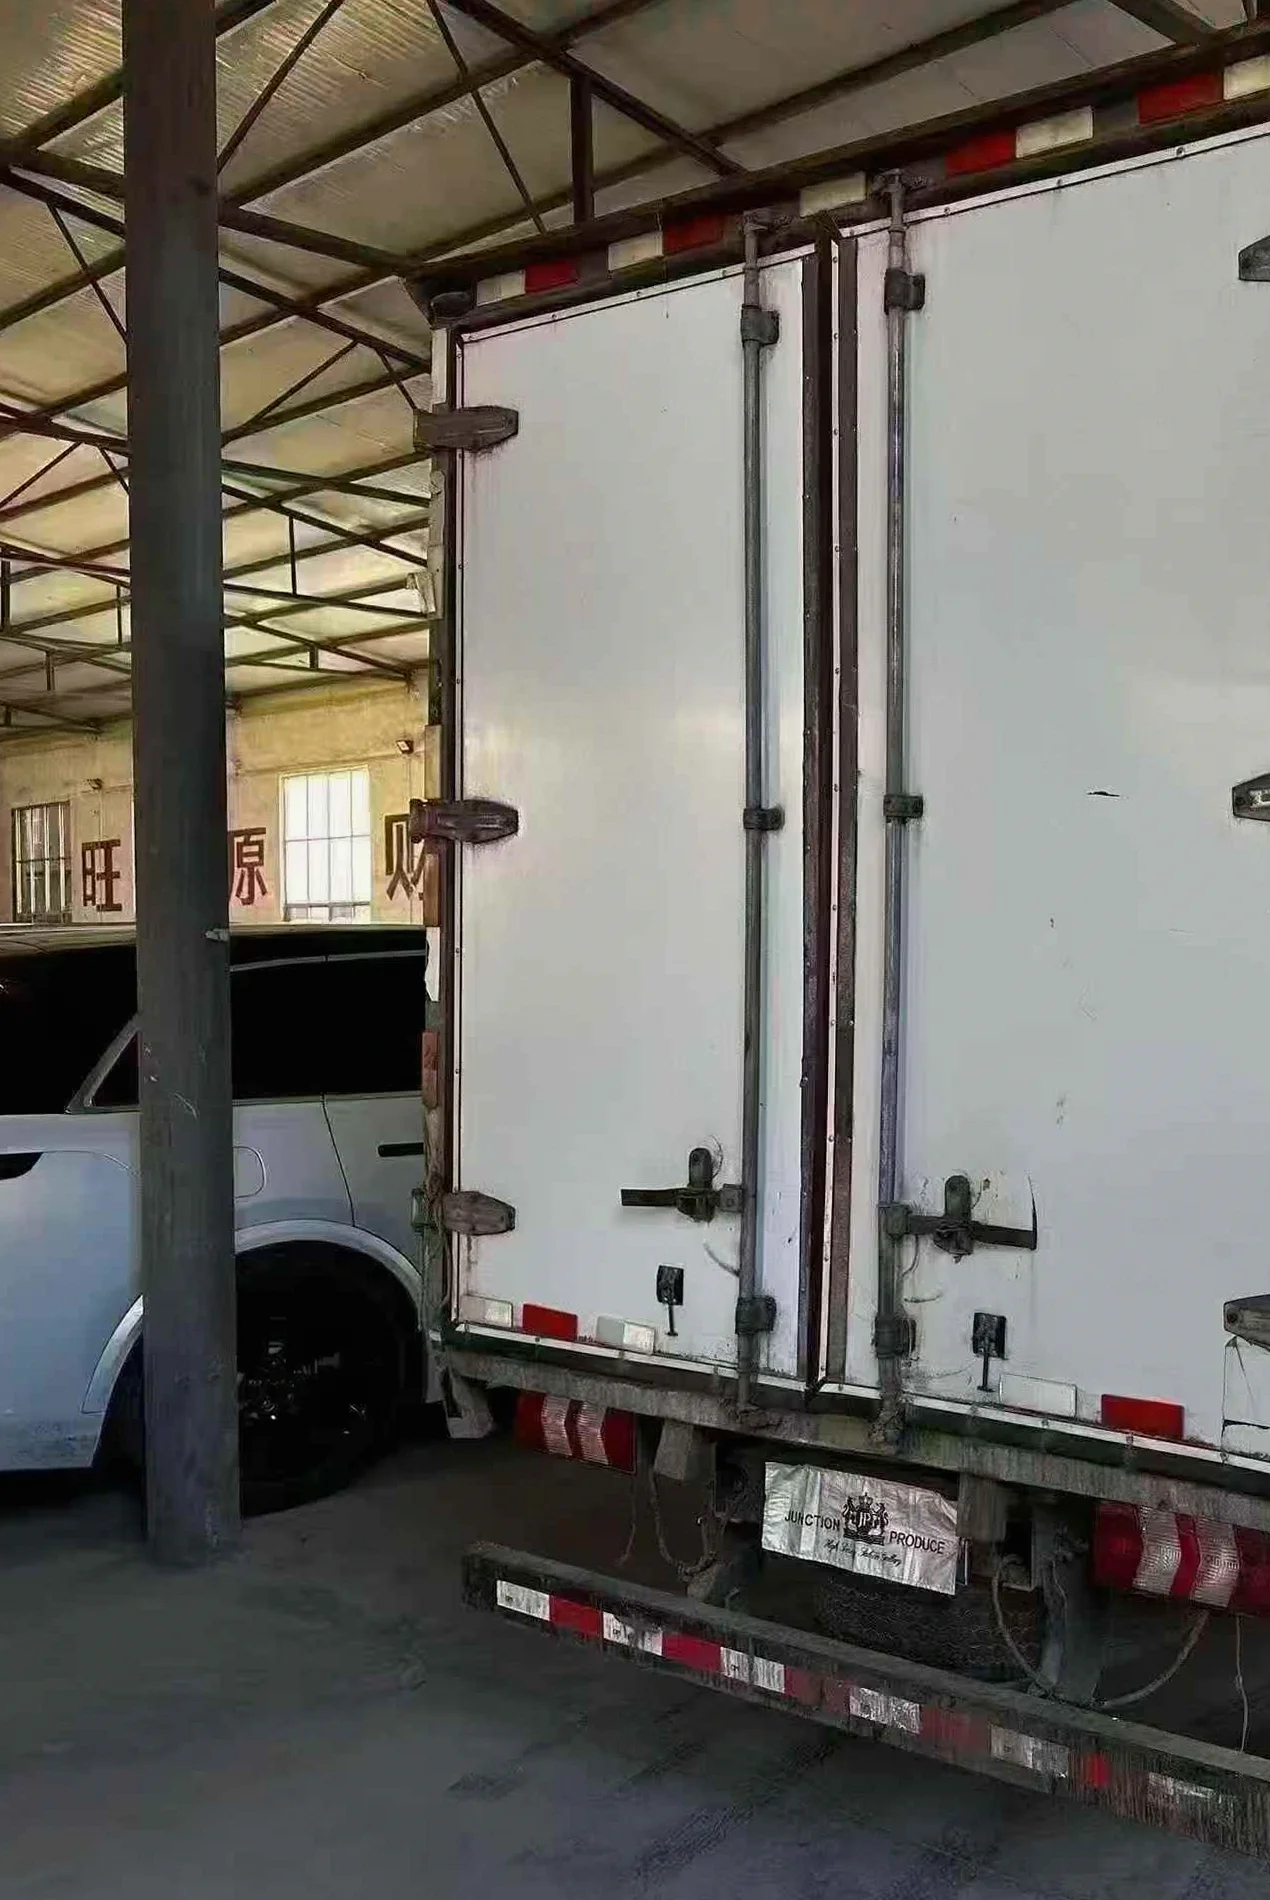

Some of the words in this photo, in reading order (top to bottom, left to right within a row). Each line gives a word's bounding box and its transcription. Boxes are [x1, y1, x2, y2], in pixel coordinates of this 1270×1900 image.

[82, 839, 122, 912] 旺
[785, 1510, 840, 1531] JUNCTION
[889, 1531, 945, 1554] PRODUCE
